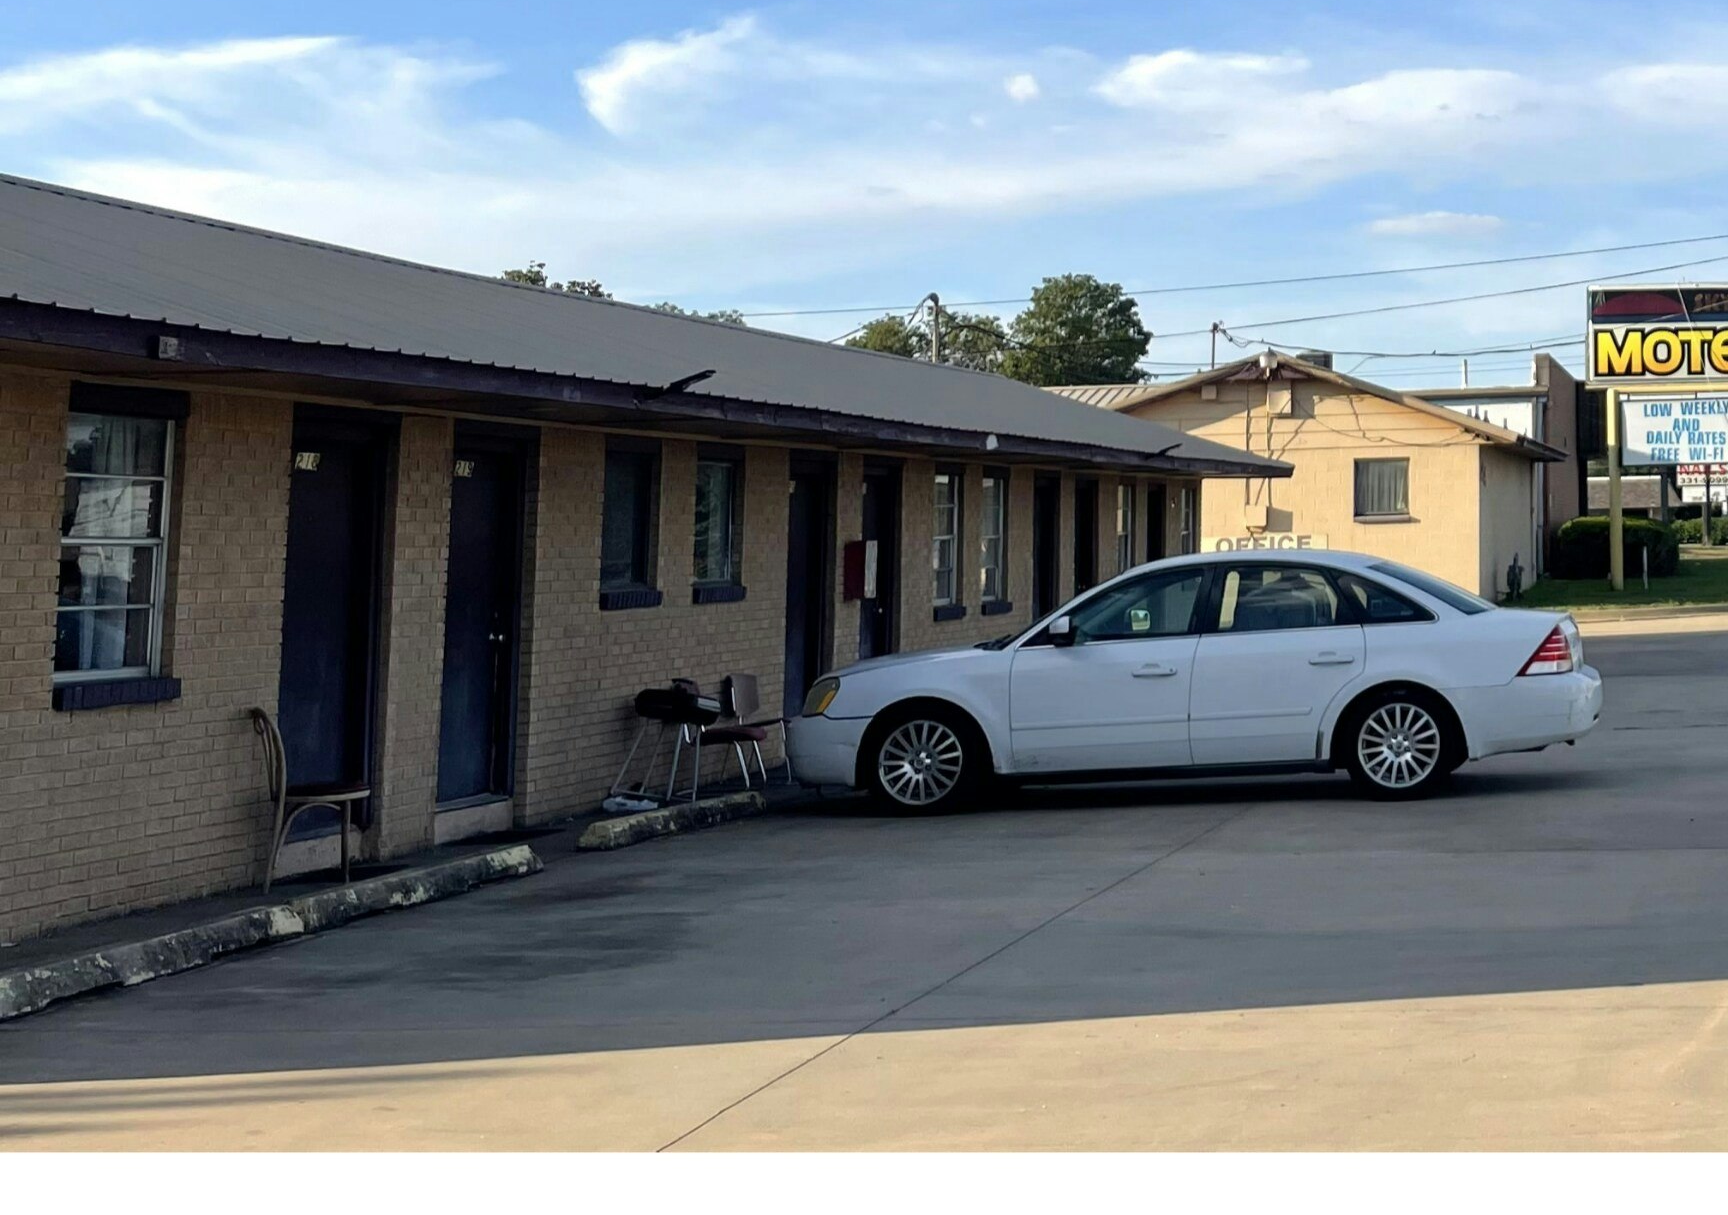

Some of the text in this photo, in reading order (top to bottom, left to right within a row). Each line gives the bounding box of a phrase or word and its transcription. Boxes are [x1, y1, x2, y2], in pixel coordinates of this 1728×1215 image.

[1643, 403, 1672, 417] LOW
[1672, 418, 1700, 431] AND
[1646, 431, 1727, 445] DAILY RATES
[1650, 447, 1724, 461] FREE WI-FI
[1215, 534, 1312, 553] OFFICE
